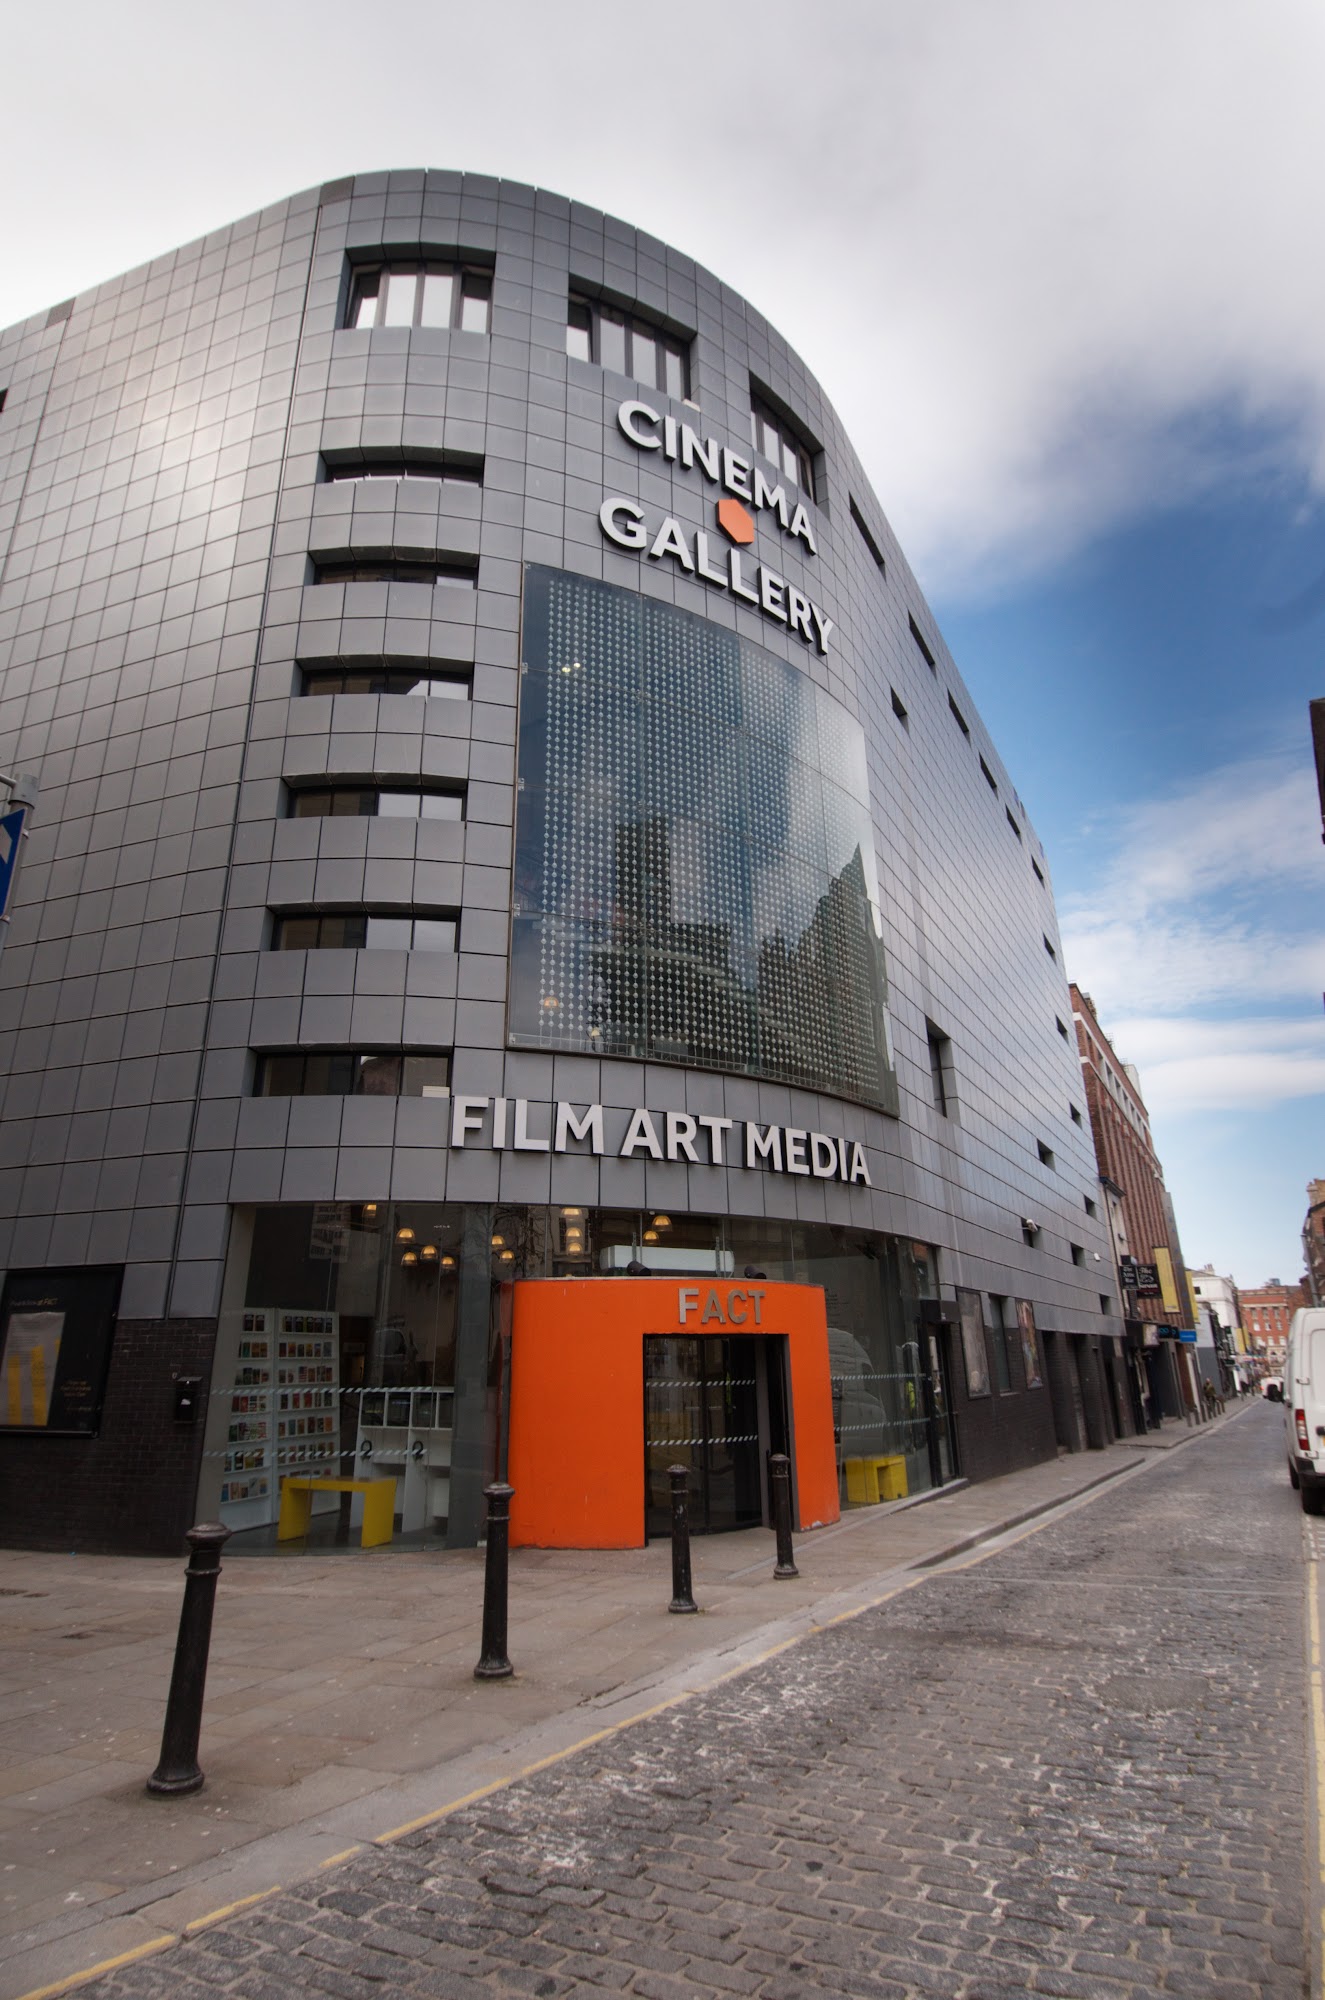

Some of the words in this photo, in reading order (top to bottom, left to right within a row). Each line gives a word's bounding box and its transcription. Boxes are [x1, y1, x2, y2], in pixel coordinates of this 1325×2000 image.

[618, 401, 817, 555] CINEMA
[600, 498, 834, 655] GALLERY
[451, 1096, 604, 1155] FILM
[620, 1109, 732, 1164] ART
[746, 1121, 872, 1186] MEDIA
[679, 1288, 766, 1324] FACT
